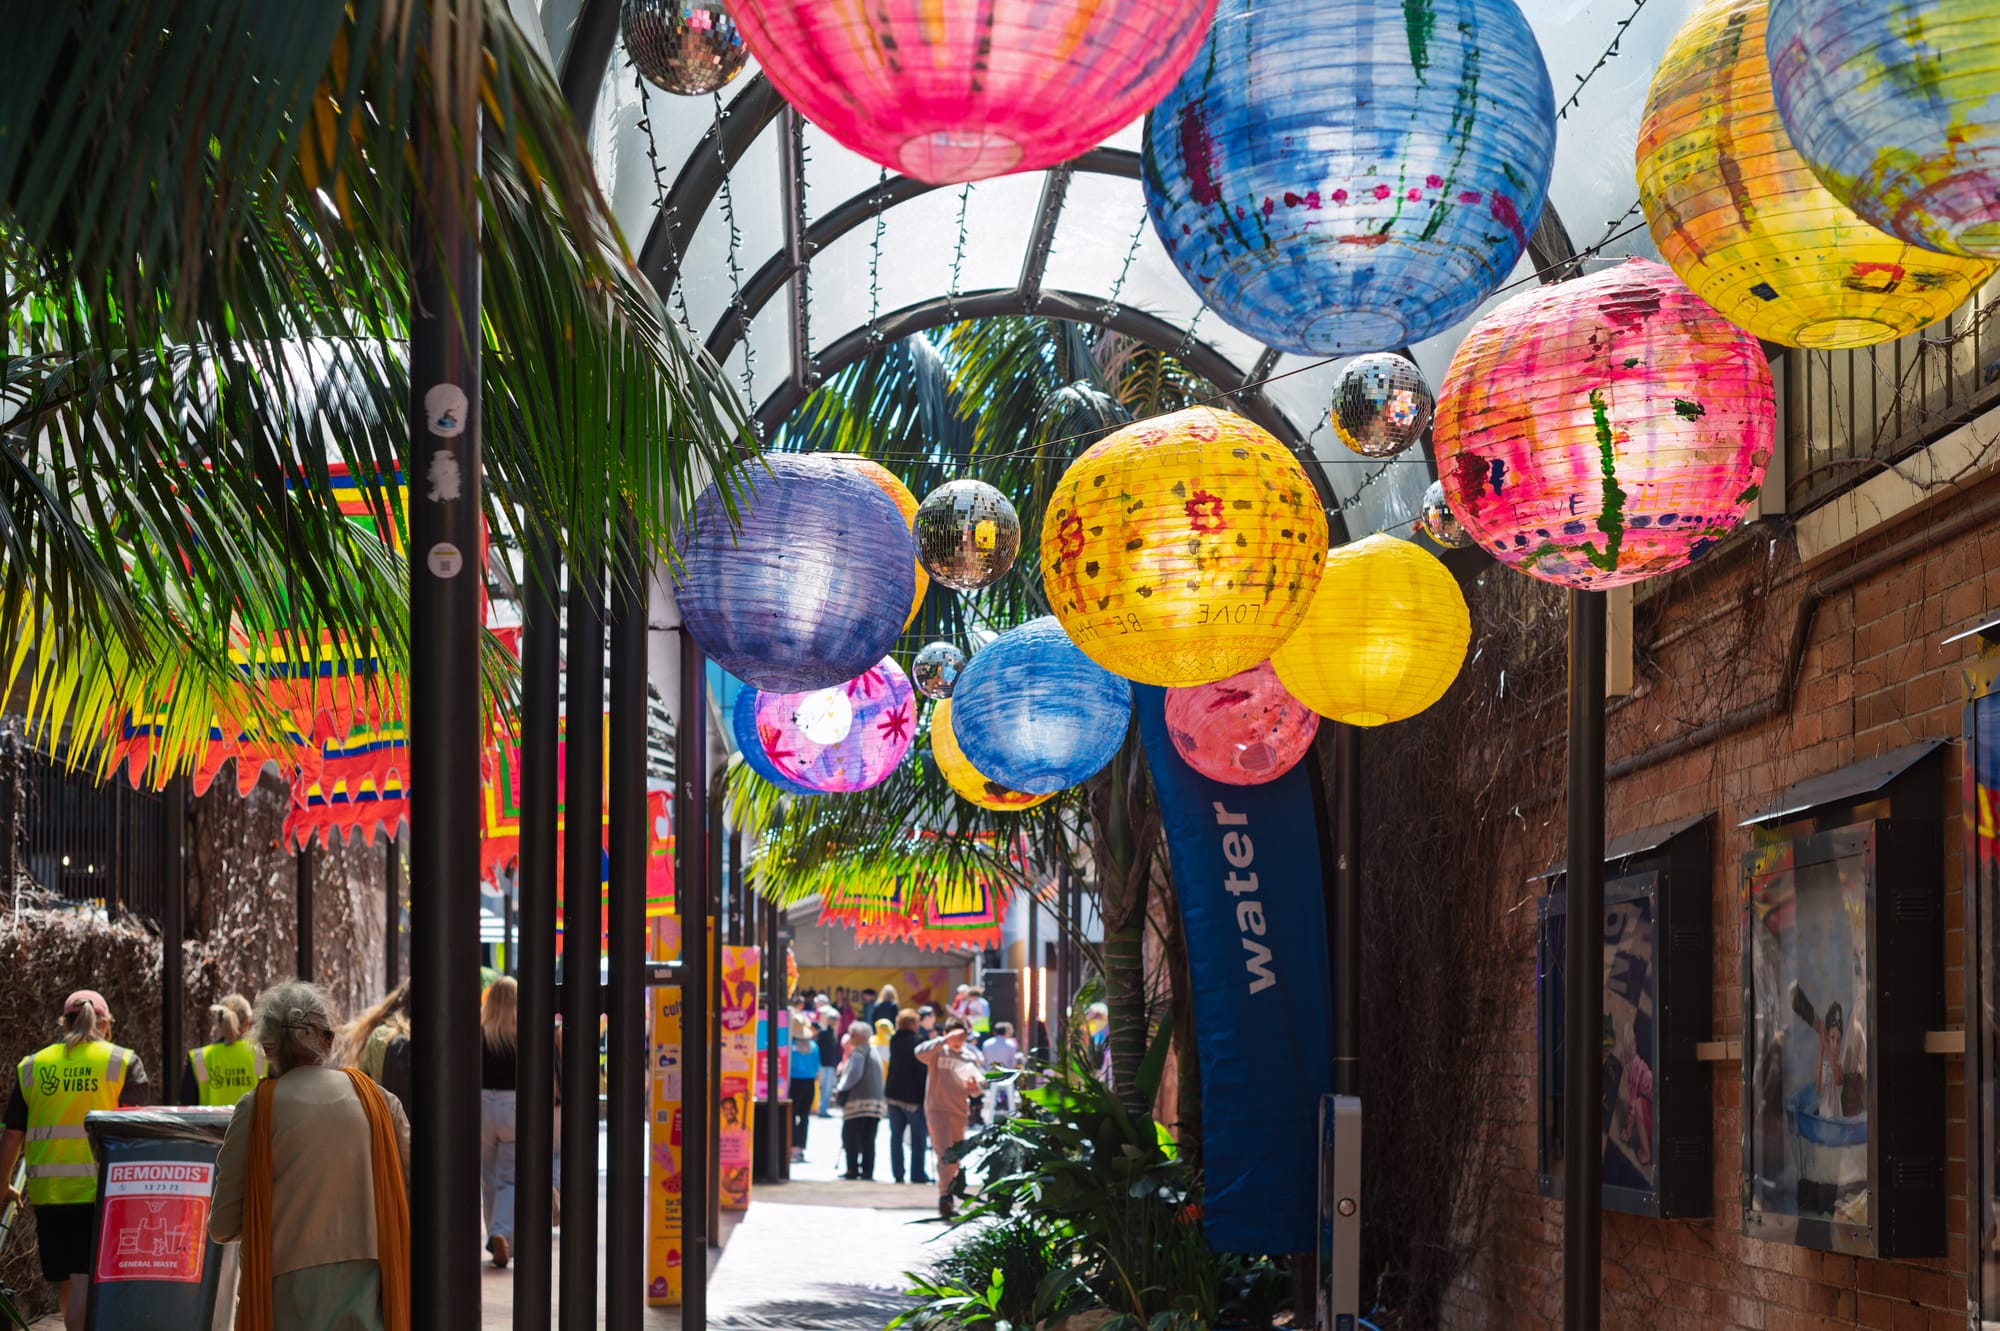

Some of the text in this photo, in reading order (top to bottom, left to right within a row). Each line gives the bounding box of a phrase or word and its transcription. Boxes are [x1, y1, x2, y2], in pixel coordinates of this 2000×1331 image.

[1197, 603, 1261, 625] LOVE
[1112, 612, 1144, 635] BE
[1212, 801, 1277, 995] water
[63, 1067, 92, 1077] CLEAN
[225, 1067, 247, 1078] CLEAN
[63, 1078, 99, 1093] VIBES
[225, 1077, 252, 1088] VIBES
[113, 1167, 201, 1181] REMONDIS
[119, 1260, 178, 1268] GENERAL WASTE
